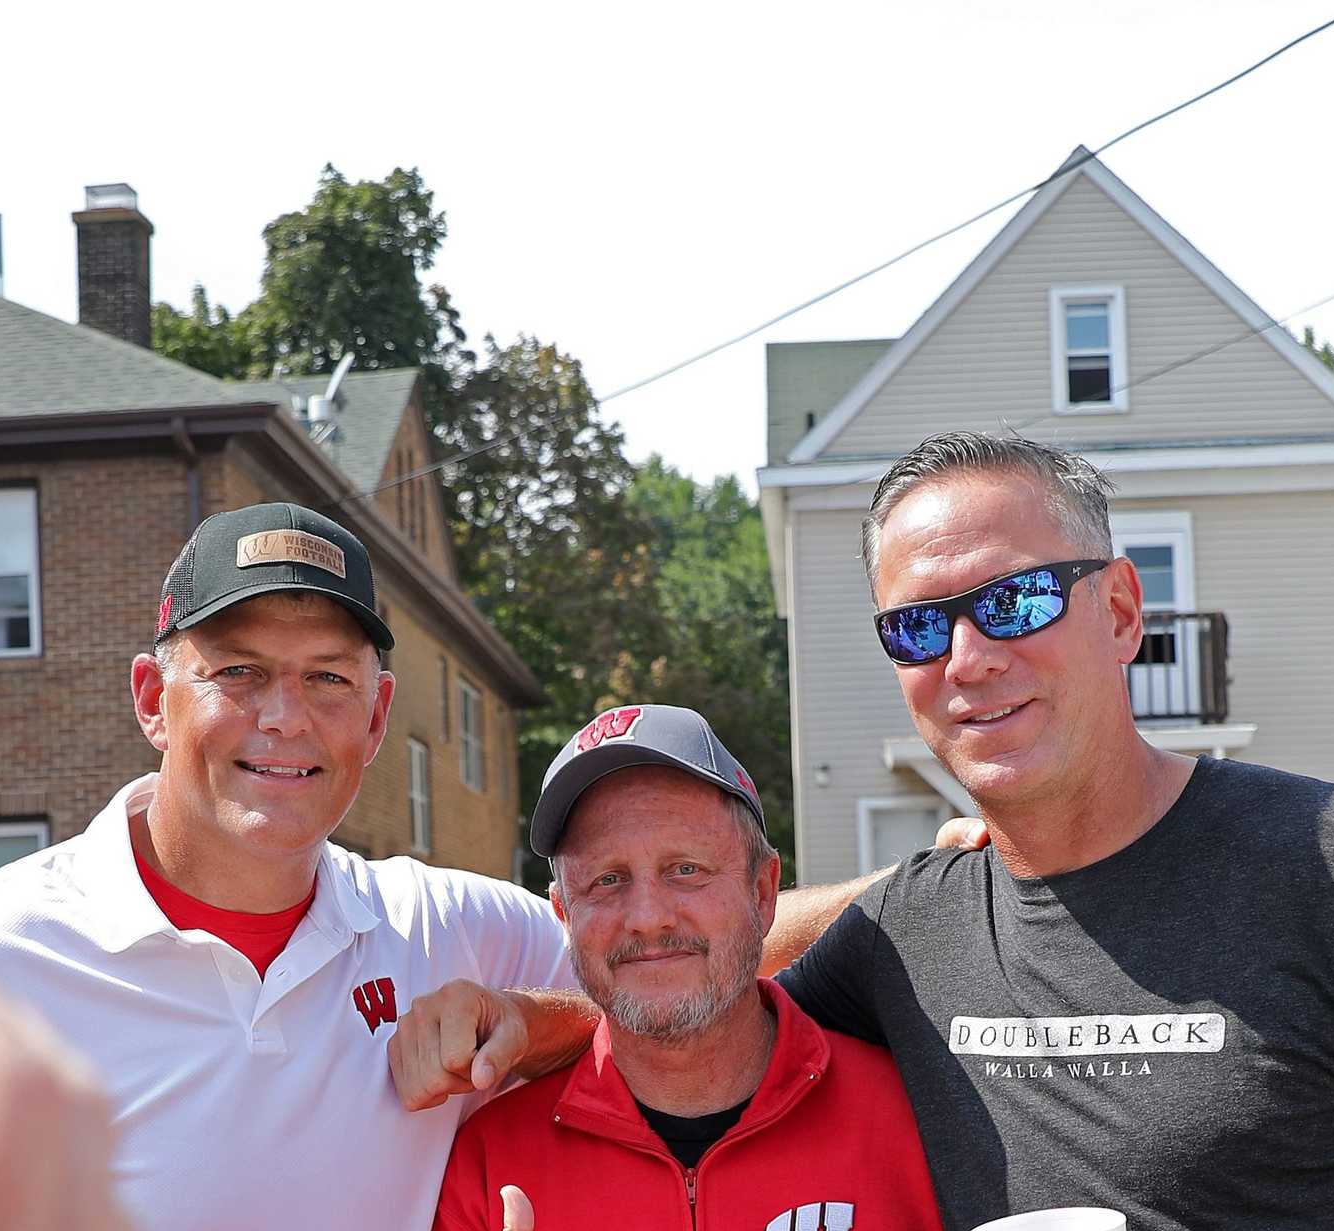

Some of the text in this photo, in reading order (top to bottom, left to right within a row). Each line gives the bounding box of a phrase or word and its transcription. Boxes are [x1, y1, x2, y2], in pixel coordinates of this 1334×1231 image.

[283, 534, 343, 561] WISCONSIN
[285, 546, 344, 572] FOOTBALL
[352, 976, 398, 1036] W
[957, 1021, 1209, 1048] DOUBLEBACK
[985, 1060, 1153, 1078] WALLA WALLA
